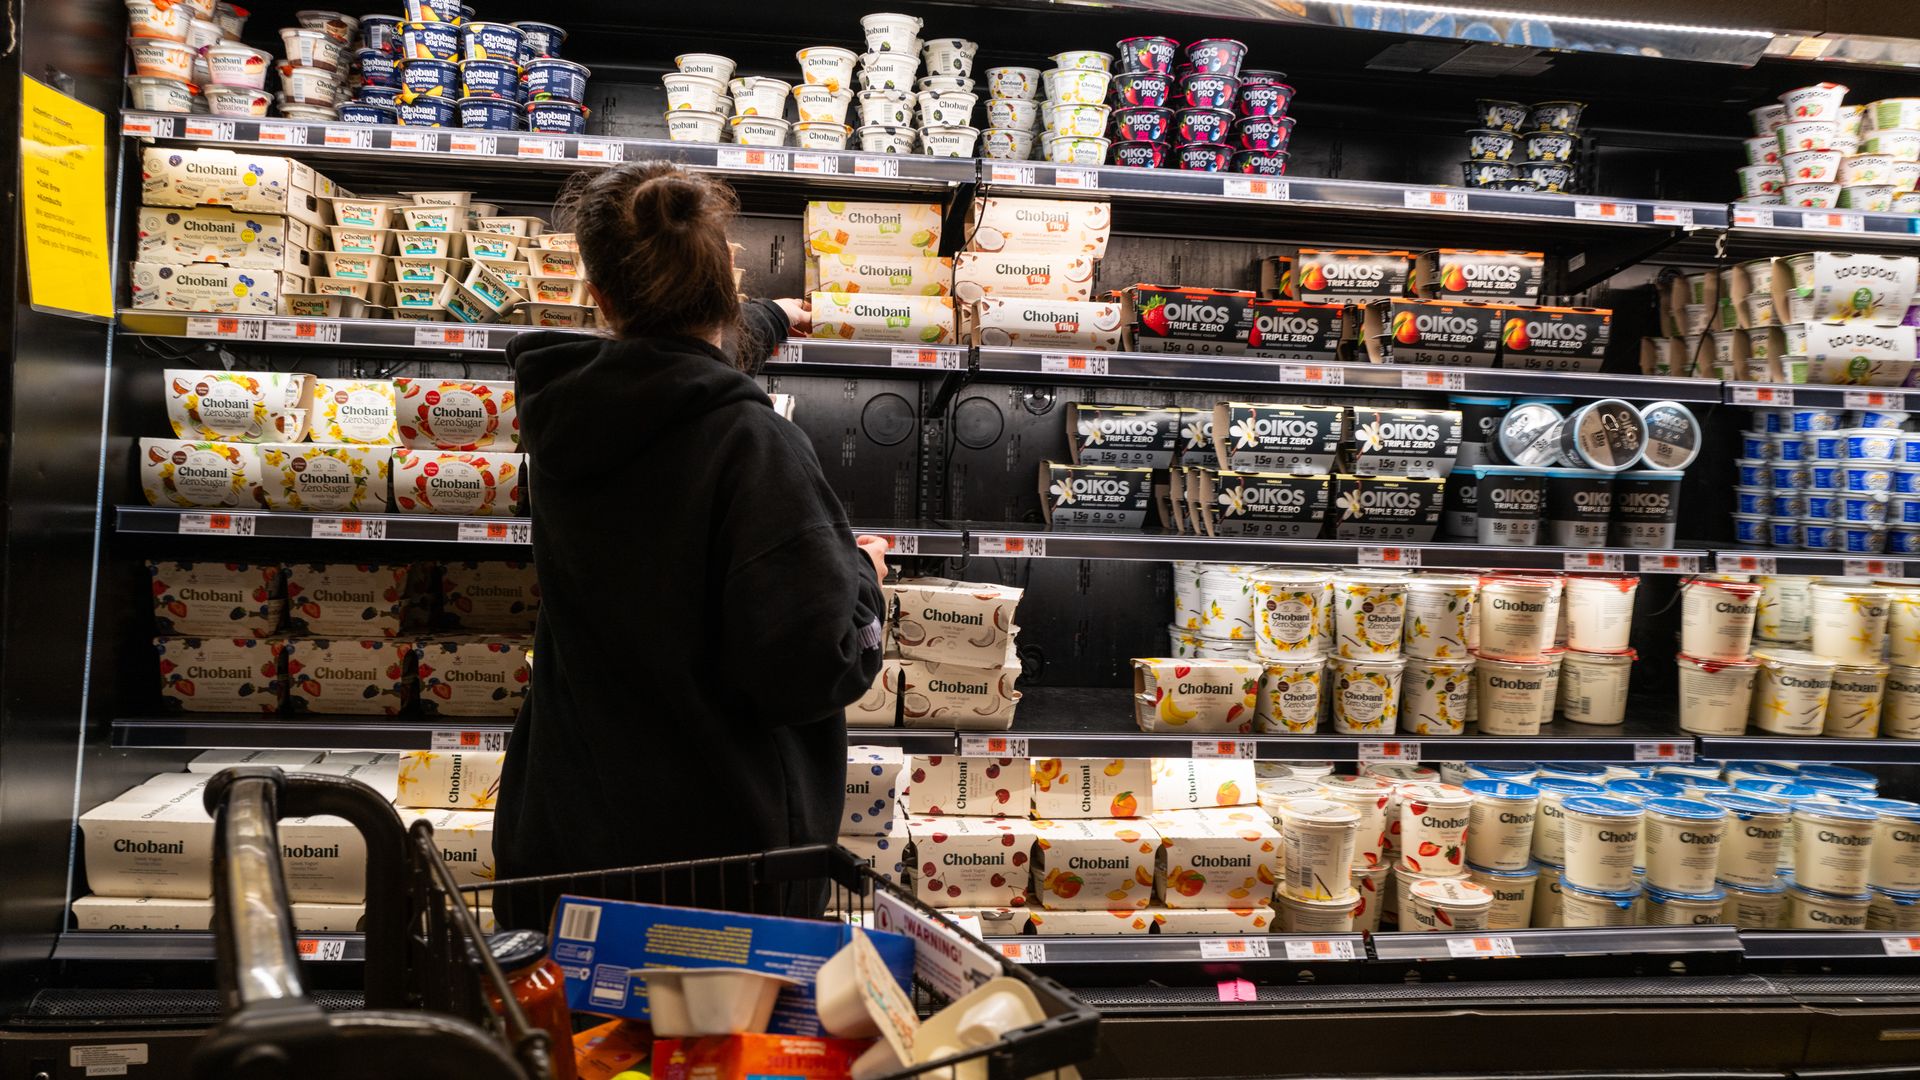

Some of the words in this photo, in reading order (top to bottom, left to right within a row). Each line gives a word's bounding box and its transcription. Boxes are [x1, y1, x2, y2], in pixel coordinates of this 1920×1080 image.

[425, 39, 440, 47] 20g
[439, 40, 457, 50] Protein
[483, 40, 496, 49] 20g
[496, 41, 517, 53] Protein
[1190, 47, 1219, 61] OIKOS
[808, 58, 839, 67] Chobani
[1132, 80, 1166, 91] OIKOS
[1190, 80, 1225, 92] OIKOS
[802, 95, 833, 103] Chobani
[1141, 89, 1158, 98] PRO
[1243, 90, 1278, 101] OIKOS
[939, 101, 969, 111] Chobani
[1250, 99, 1268, 107] PRO
[1126, 114, 1160, 125] OIKOS
[1186, 114, 1221, 126] OIKOS
[744, 126, 776, 136] Chobani
[1193, 123, 1211, 132] PRO
[1244, 122, 1279, 134] OIKOS
[808, 131, 840, 143] Chobani
[929, 136, 960, 144] Chobani
[1120, 148, 1154, 159] OIKOS
[1183, 150, 1217, 163] OIKOS
[1251, 156, 1284, 168] OIKOS
[186, 162, 238, 177] Chobani
[848, 211, 901, 225] Chobani
[1015, 208, 1069, 223] Chobani
[183, 220, 236, 234] Chobani
[882, 222, 898, 234] flip
[1049, 221, 1066, 232] flip
[859, 264, 912, 277] Chobani
[995, 262, 1050, 276] Chobani
[1322, 263, 1385, 280] OIKOS
[1462, 264, 1521, 282] OIKOS
[1834, 265, 1859, 280] too
[176, 274, 228, 288] Chobani
[893, 275, 908, 286] flip
[1031, 274, 1046, 285] flip
[1326, 279, 1354, 288] TRIPLE
[1355, 279, 1380, 288] ZERO
[1466, 280, 1493, 289] TRIPLE
[1493, 280, 1518, 290] ZERO
[854, 304, 911, 319] Chobani
[1022, 309, 1079, 323] Chobani
[1163, 302, 1230, 324] OIKOS
[891, 317, 906, 328] flip
[1058, 322, 1075, 333] flip
[1168, 320, 1198, 331] TRIPLE
[1199, 321, 1225, 333] ZERO
[1256, 315, 1319, 335] OIKOS
[1415, 314, 1478, 335] OIKOS
[1525, 321, 1588, 341] OIKOS
[1260, 332, 1290, 342] TRIPLE
[1290, 333, 1315, 344] ZERO
[1420, 332, 1449, 342] TRIPLE
[1449, 333, 1474, 344] ZERO
[1529, 338, 1558, 349] TRIPLE
[1558, 339, 1583, 350] ZERO
[1828, 333, 1853, 349] too
[202, 397, 249, 409] Chobani
[203, 408, 224, 417] Zero
[223, 409, 249, 419] Sugar
[342, 405, 389, 416] Chobani
[432, 406, 482, 418] Chobani
[342, 416, 363, 425] Zero
[363, 417, 389, 427] Sugar
[434, 417, 456, 426] Zero
[455, 418, 483, 428] Sugar
[1653, 410, 1690, 430] OIKOS
[1100, 419, 1158, 436] OIKOS
[1255, 419, 1319, 438] OIKOS
[1379, 422, 1440, 442] OIKOS
[1105, 434, 1131, 443] TRIPLE
[1132, 435, 1154, 444] ZERO
[1259, 436, 1288, 445] TRIPLE
[1288, 437, 1314, 447] ZERO
[1383, 439, 1411, 449] TRIPLE
[1412, 440, 1436, 450] ZERO
[178, 466, 228, 478] Chobani
[179, 477, 201, 487] Zero
[200, 478, 228, 489] Sugar
[299, 473, 350, 485] Chobani
[431, 478, 480, 490] Chobani
[301, 484, 323, 493] Zero
[322, 485, 350, 495] Sugar
[1072, 478, 1130, 496] OIKOS
[432, 489, 453, 498] Zero
[453, 489, 481, 499] Sugar
[1076, 493, 1103, 502] TRIPLE
[1104, 494, 1126, 504] ZERO
[1242, 487, 1305, 507] OIKOS
[1360, 490, 1421, 509] OIKOS
[1490, 488, 1541, 504] OIKOS
[1247, 504, 1276, 514] TRIPLE
[1276, 504, 1301, 515] ZERO
[1364, 507, 1392, 516] TRIPLE
[1392, 508, 1417, 517] ZERO
[1494, 502, 1520, 511] TRIPLE
[1520, 502, 1538, 511] ZERO
[179, 587, 243, 604] Chobani
[312, 590, 375, 604] Chobani
[465, 584, 523, 599] Chobani
[1493, 597, 1544, 613] Chobani
[922, 607, 984, 626] Chobani
[1271, 612, 1311, 622] Chobani
[187, 665, 252, 681] Chobani
[314, 666, 377, 682] Chobani
[444, 669, 506, 684] Chobani
[927, 679, 988, 695] Chobani
[1489, 675, 1543, 690] Chobani
[1178, 682, 1234, 696] Chobani
[1344, 691, 1383, 702] Chobani
[448, 753, 462, 803] Chobani
[1188, 760, 1198, 803] Chobani
[956, 761, 968, 810] Chobani
[1080, 764, 1091, 813] Chobani
[114, 838, 184, 855] Chobani
[943, 852, 1005, 867] Chobani
[1068, 856, 1130, 870] Chobani
[1191, 854, 1252, 868] Chobani
